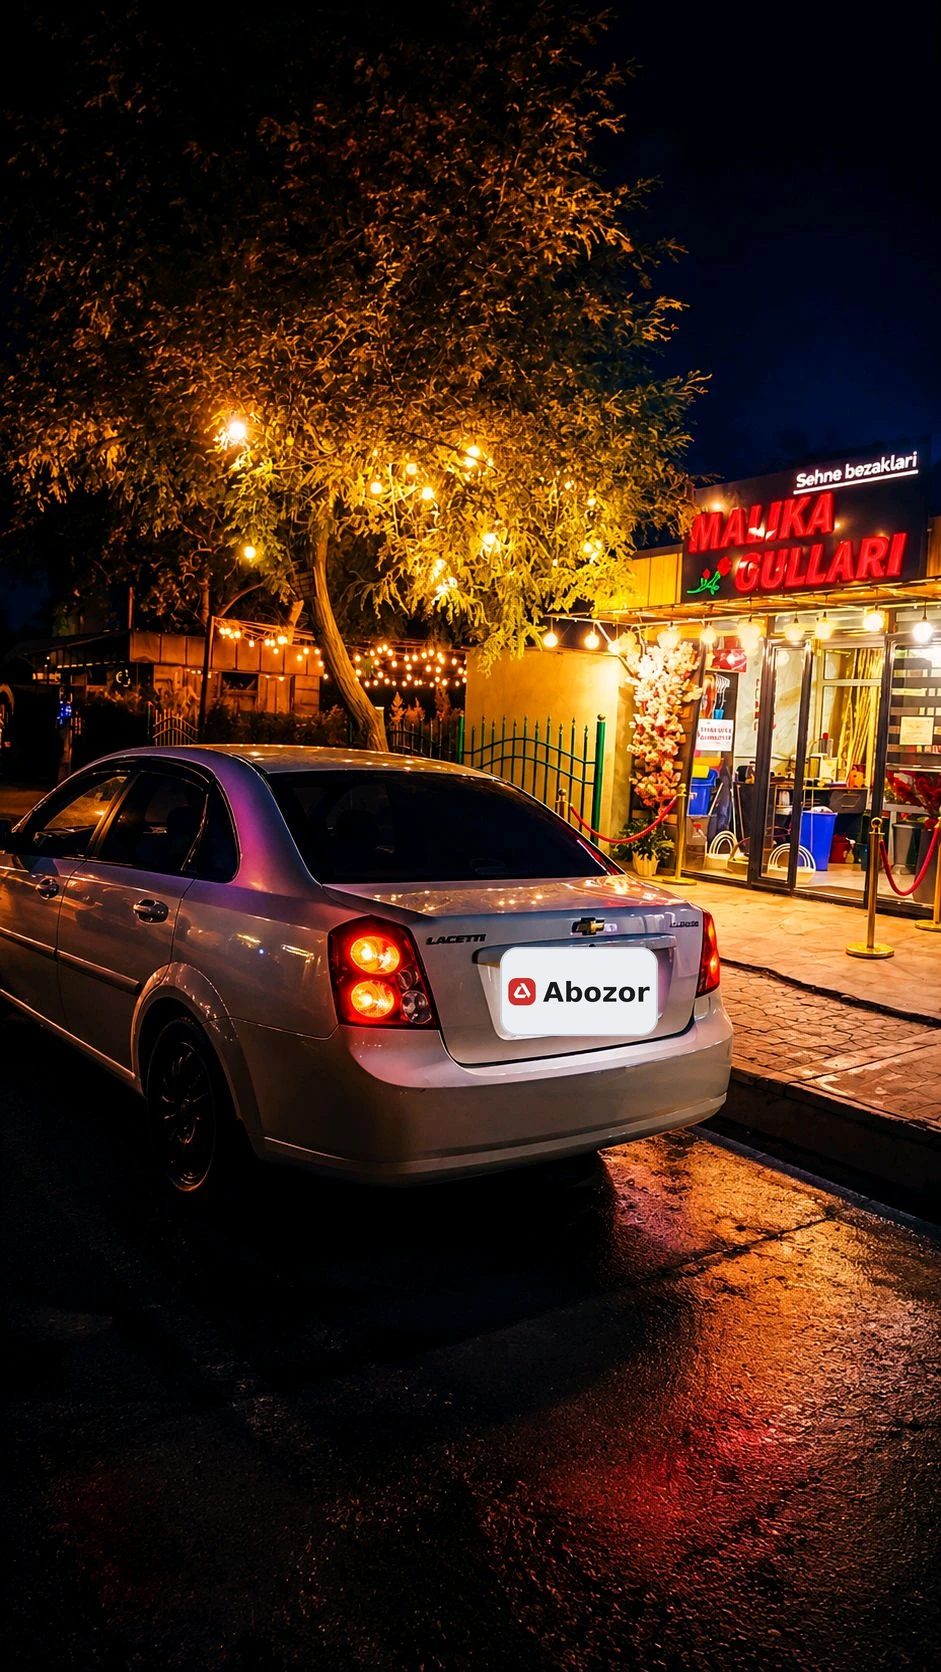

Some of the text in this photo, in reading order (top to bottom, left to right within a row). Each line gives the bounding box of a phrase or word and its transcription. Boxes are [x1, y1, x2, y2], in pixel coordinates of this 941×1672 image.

[796, 451, 918, 488] Sehne bezaklari
[688, 491, 836, 553] MALIKA
[734, 532, 908, 593] GULLARI
[426, 934, 487, 945] LACETTI
